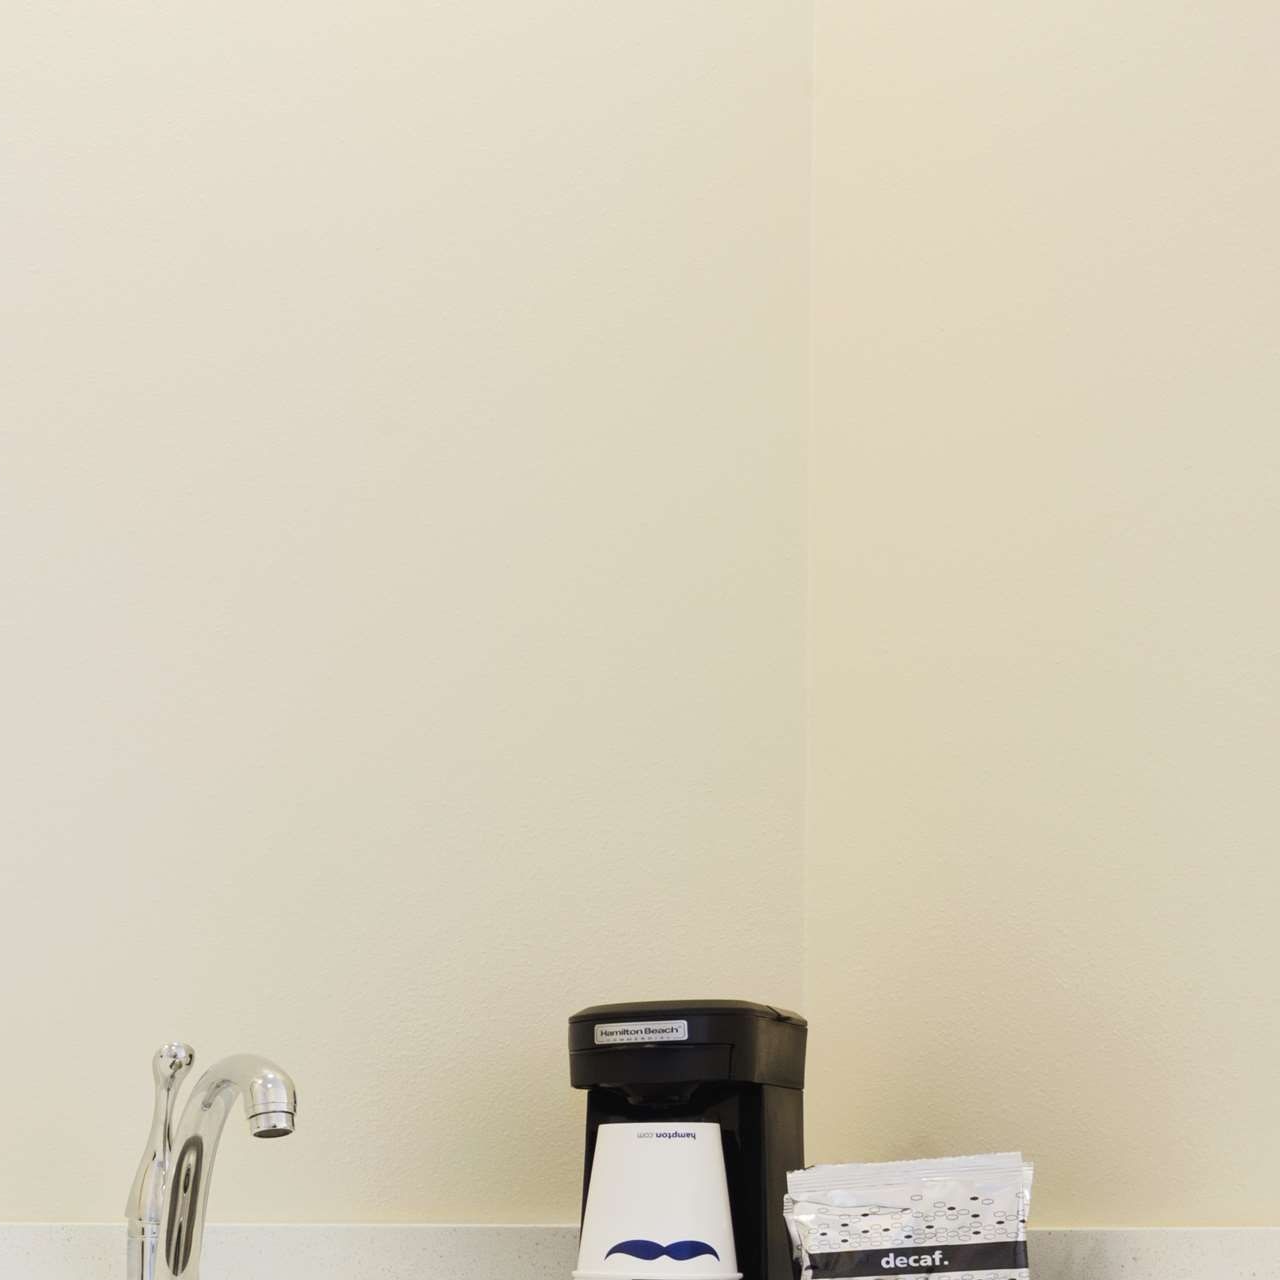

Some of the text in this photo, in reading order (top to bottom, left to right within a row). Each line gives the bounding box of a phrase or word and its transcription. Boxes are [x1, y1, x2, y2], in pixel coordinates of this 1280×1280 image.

[600, 1026, 679, 1037] Hamilton Beach
[881, 1250, 950, 1269] decaf.
